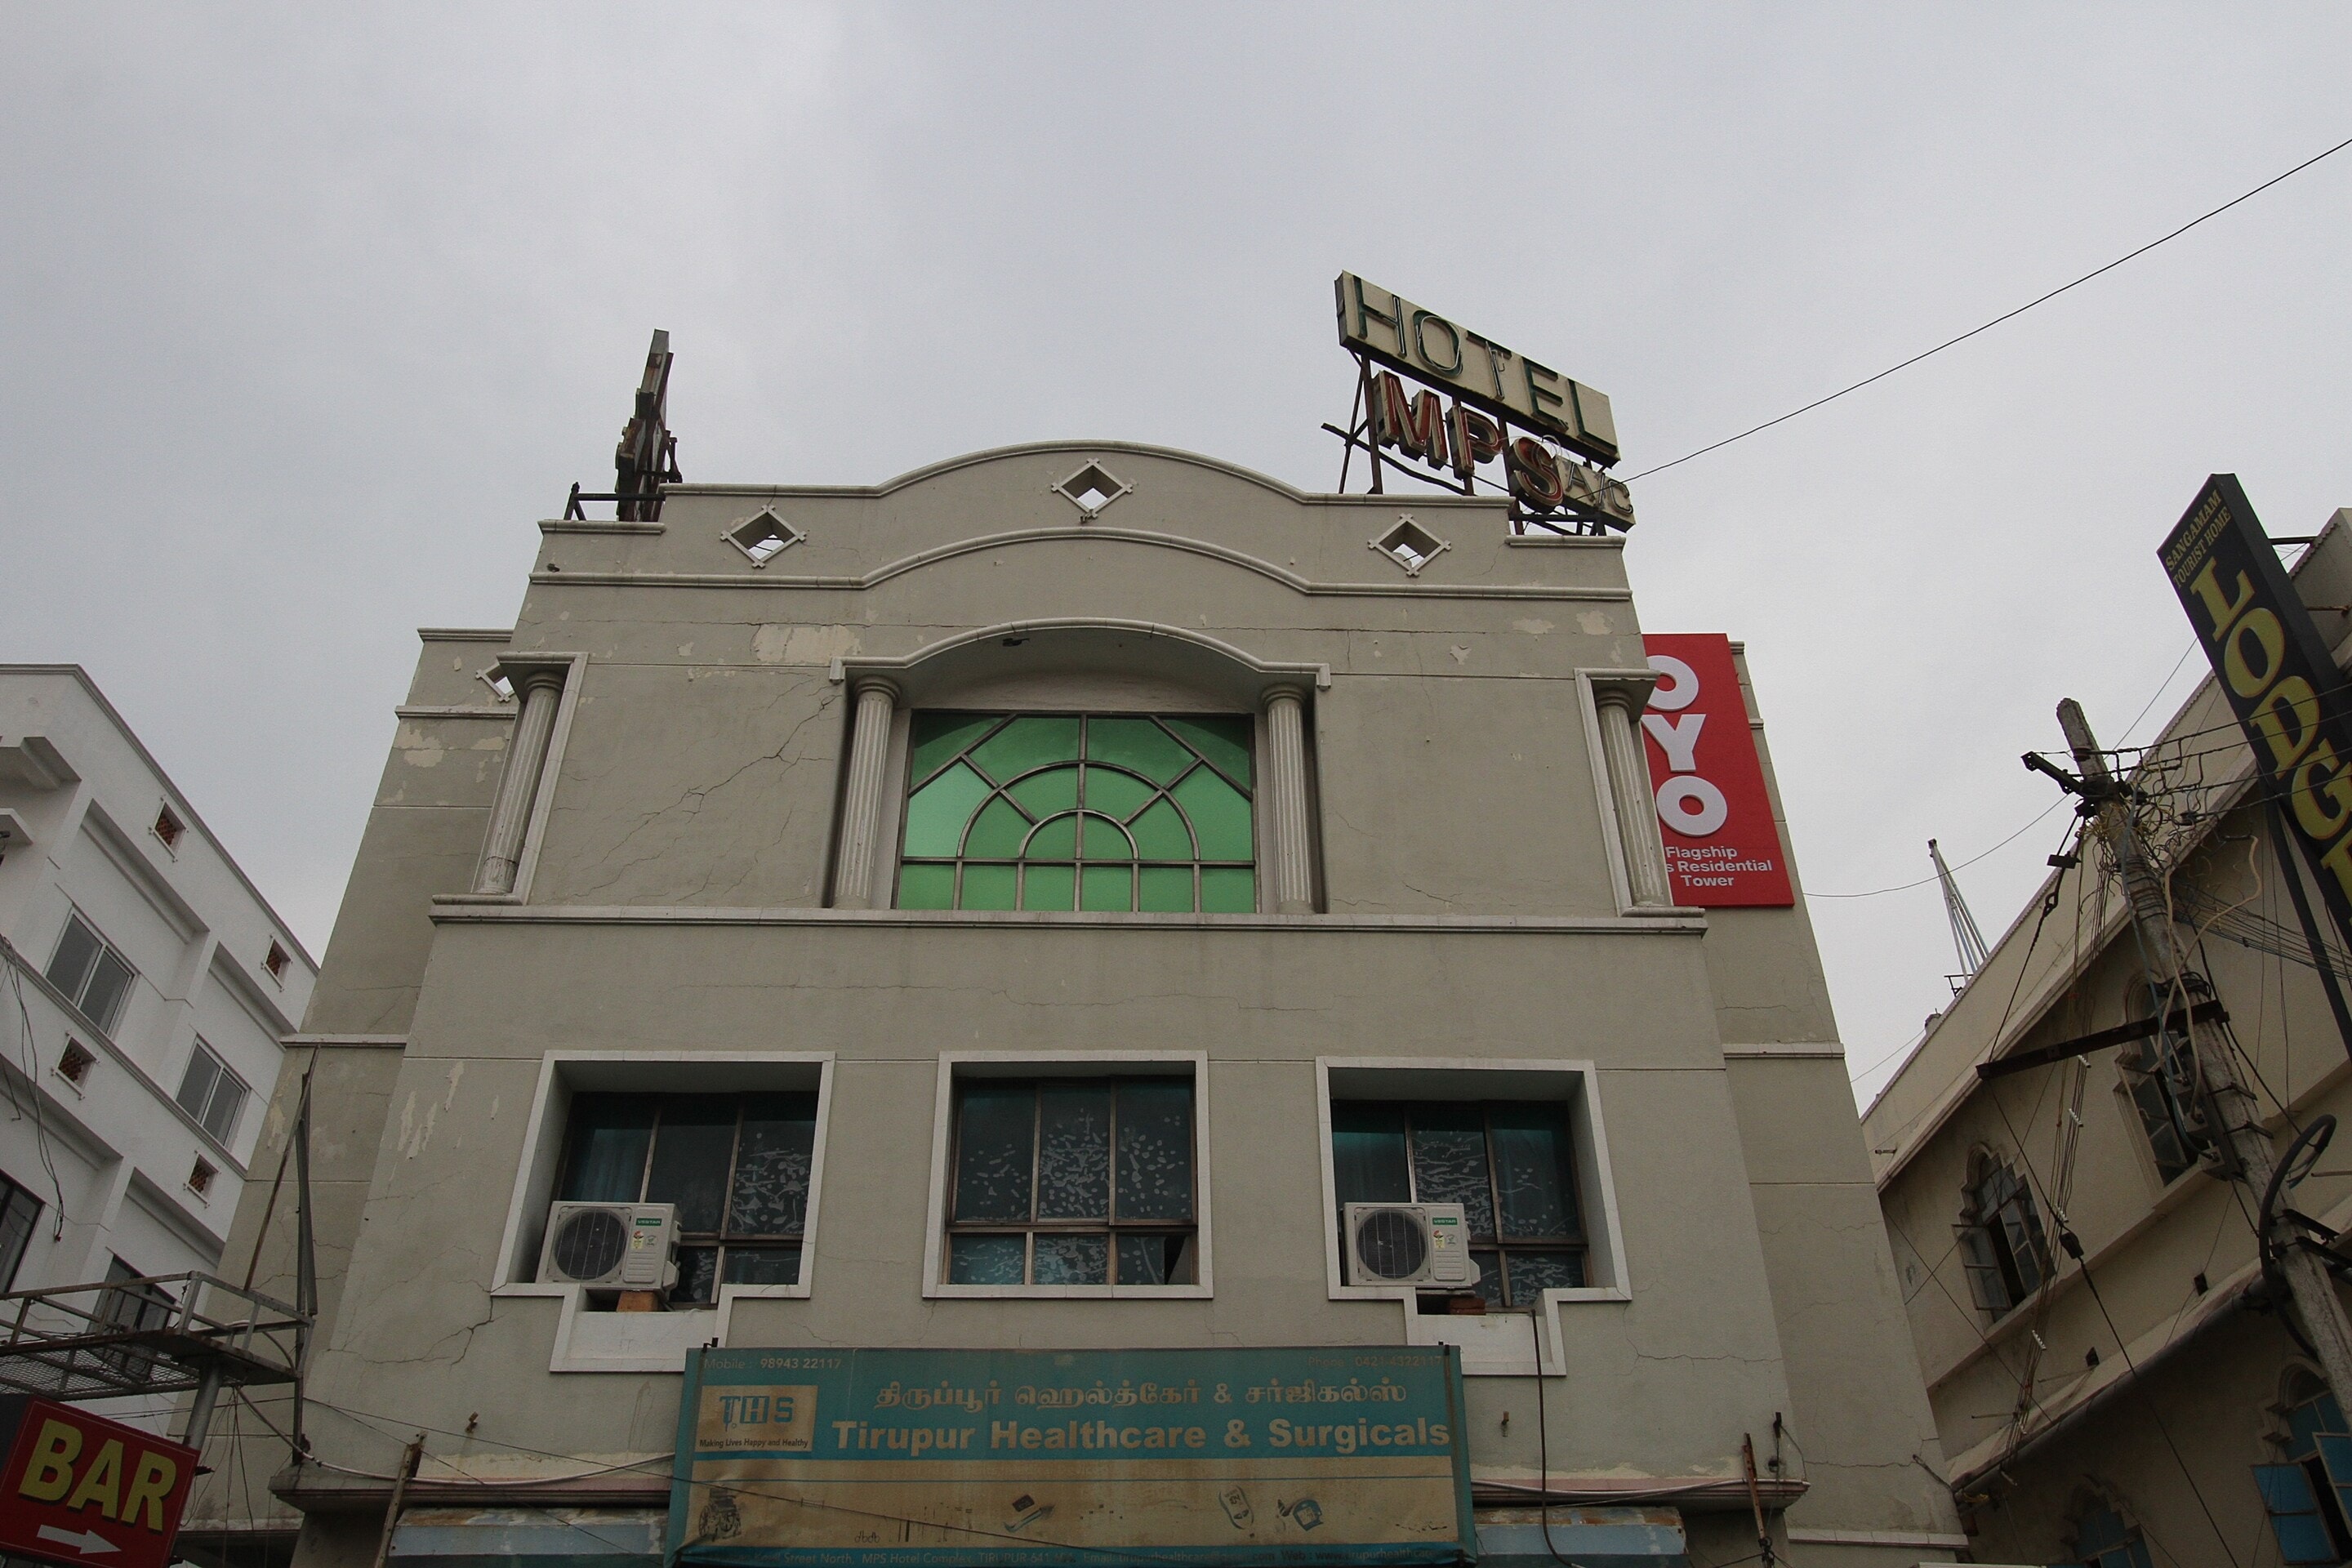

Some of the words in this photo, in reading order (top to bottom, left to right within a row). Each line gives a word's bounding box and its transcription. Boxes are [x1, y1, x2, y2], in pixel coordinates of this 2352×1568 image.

[1352, 274, 1618, 457] HOTEL
[1372, 370, 1563, 512] MPS
[2165, 488, 2222, 571] SANGAMAM
[2173, 539, 2207, 587] TOURIST
[2204, 506, 2231, 546] HOME
[1641, 655, 1727, 837] OYO
[1665, 846, 1738, 860] Flagship
[1677, 860, 1772, 872] Residential
[1681, 875, 1734, 887] Tower
[704, 1357, 745, 1369] Mobile
[760, 1357, 799, 1370] 98943
[802, 1357, 841, 1370] 22117
[874, 1380, 1002, 1413] திருப்பூர்
[1214, 1383, 1233, 1404] &
[699, 1438, 724, 1449] Making
[725, 1438, 742, 1447] Lives
[744, 1438, 766, 1448] Happy
[768, 1438, 780, 1446] and
[782, 1438, 808, 1448] Healthy
[831, 1420, 976, 1457] Tirupur
[991, 1419, 1206, 1450] Healthcare
[1223, 1419, 1251, 1448] &
[1268, 1417, 1450, 1454] Surgicals
[18, 1418, 177, 1533] BAR
[784, 1552, 816, 1564] Street
[862, 1553, 886, 1564] MPS
[890, 1553, 920, 1564] Hotel
